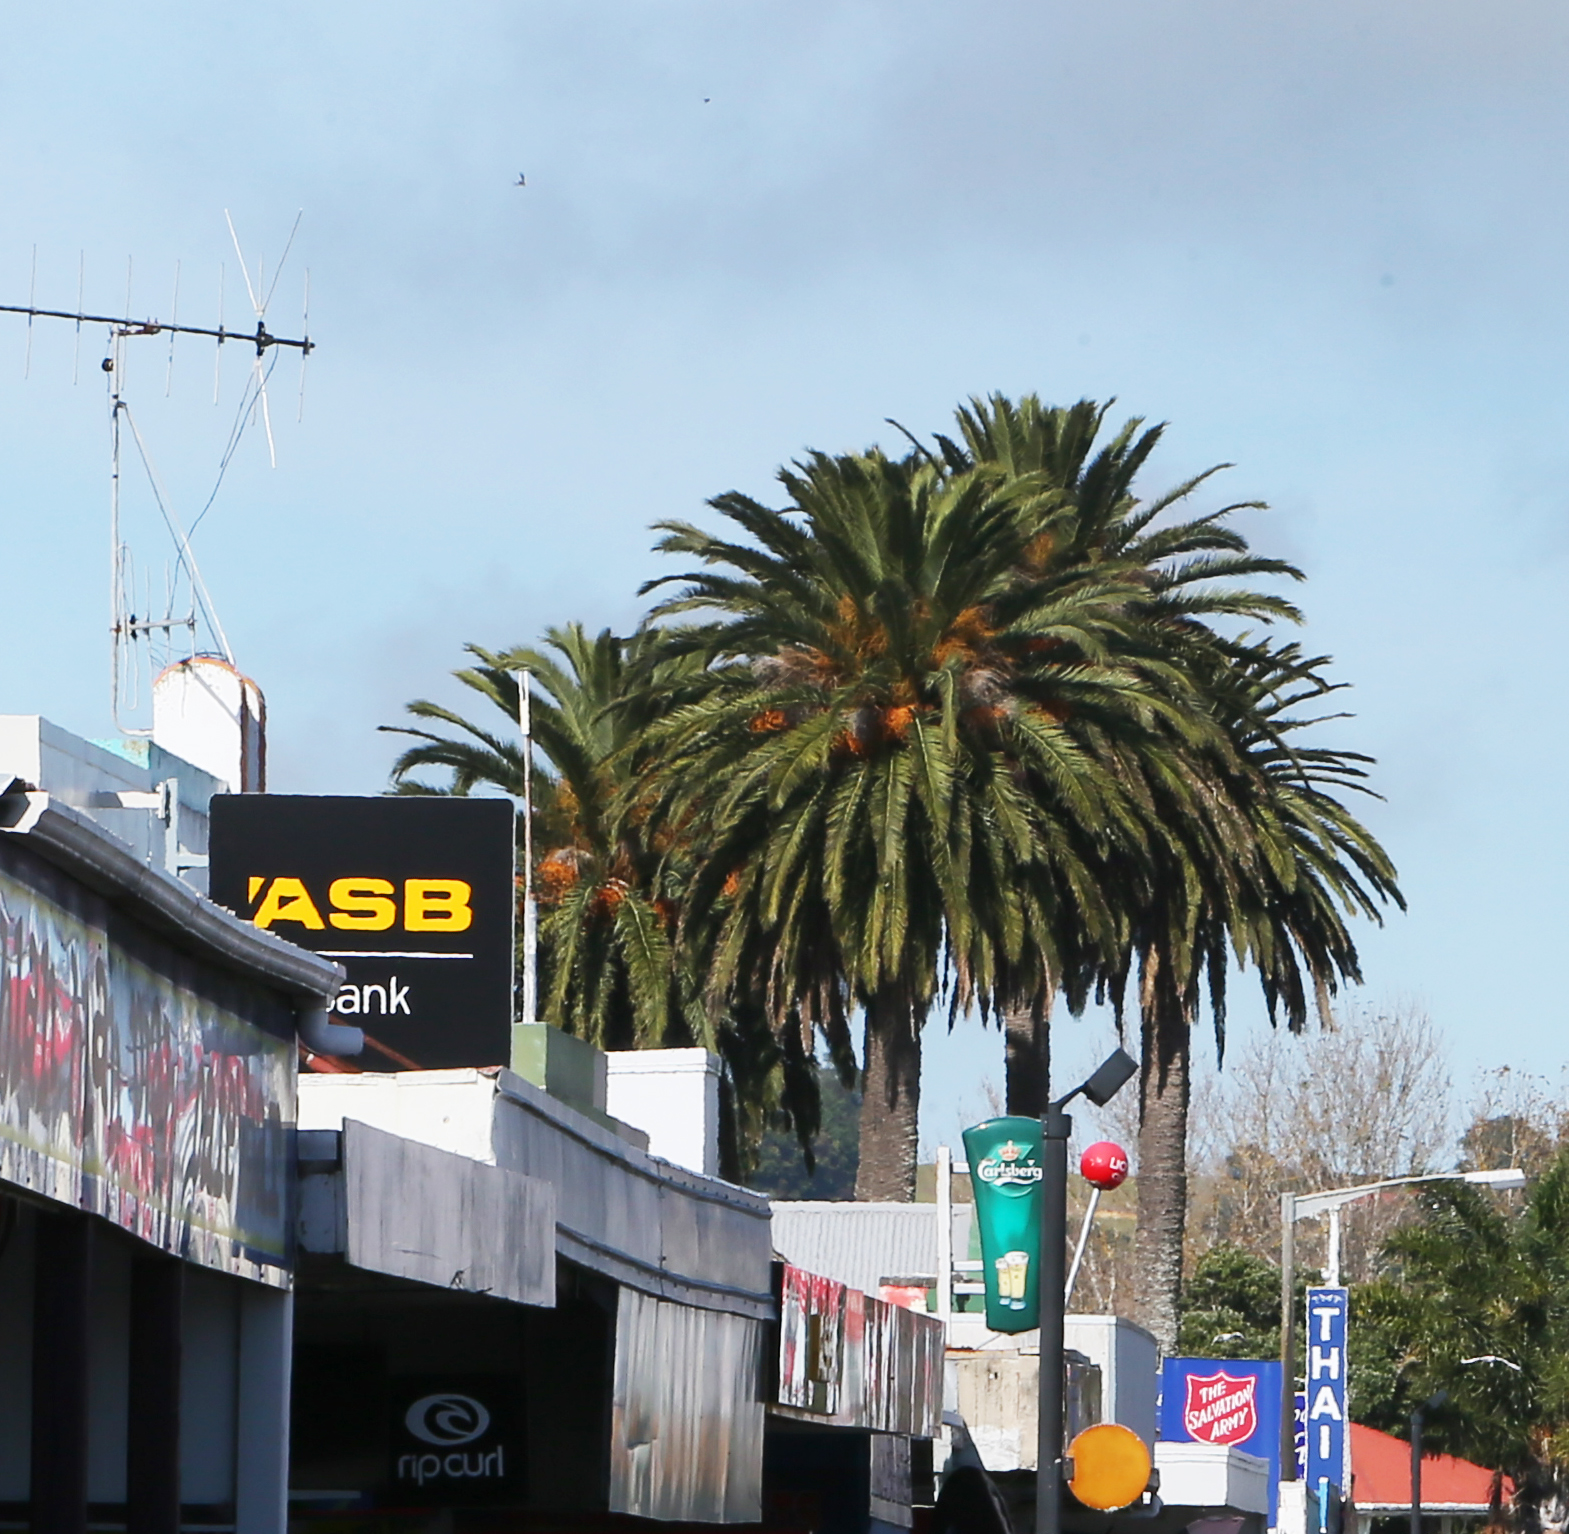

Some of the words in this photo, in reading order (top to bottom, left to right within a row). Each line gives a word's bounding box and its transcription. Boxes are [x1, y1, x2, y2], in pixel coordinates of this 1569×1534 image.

[248, 876, 473, 932] ASB
[326, 976, 411, 1015] ank
[977, 1158, 1043, 1184] Carlsberg
[1200, 1381, 1226, 1403] THE
[1310, 1307, 1342, 1459] THAI
[1189, 1384, 1251, 1430] SALVATION
[1210, 1407, 1249, 1440] ARMY
